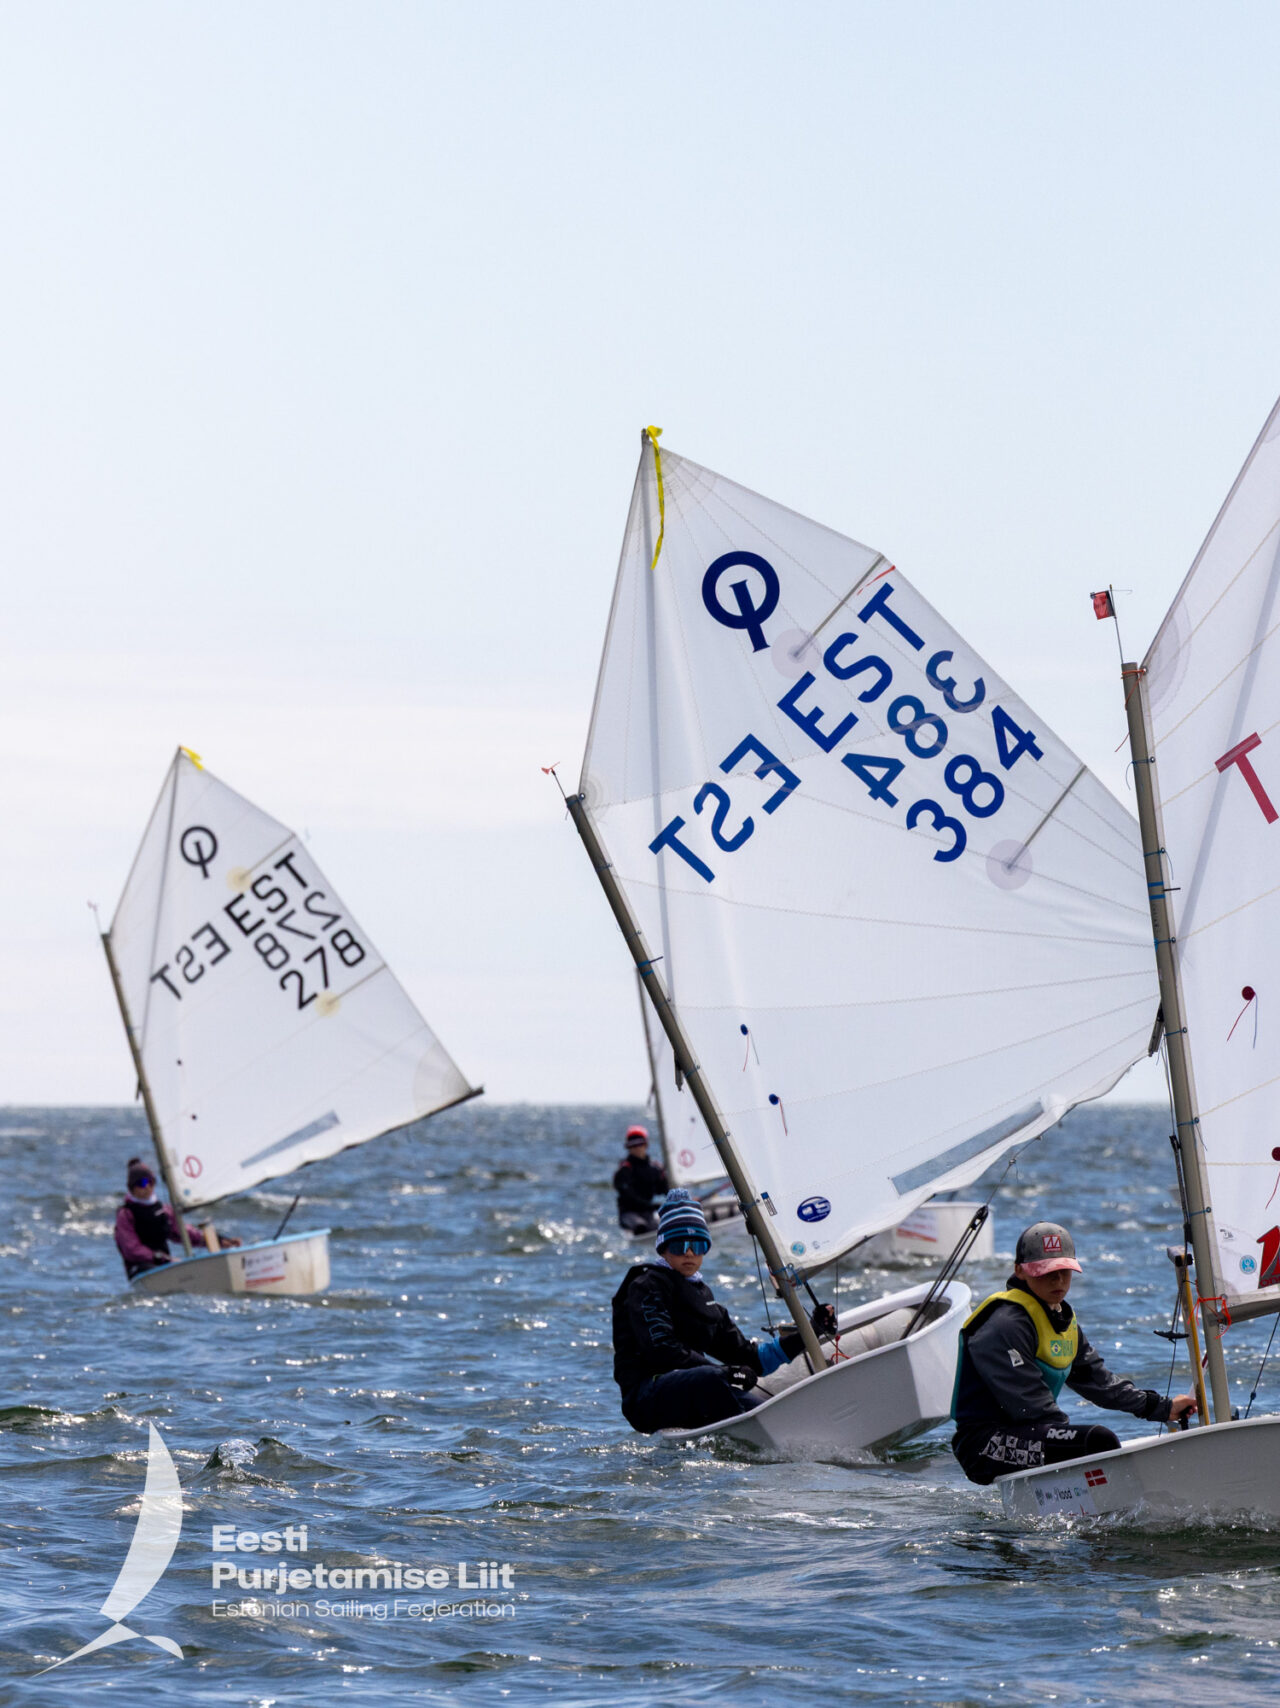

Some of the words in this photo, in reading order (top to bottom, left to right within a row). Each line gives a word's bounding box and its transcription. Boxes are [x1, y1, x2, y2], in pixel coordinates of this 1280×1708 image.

[777, 582, 926, 754] EST
[906, 704, 1044, 863] 384
[223, 851, 309, 937] EST
[279, 928, 366, 1011] 278
